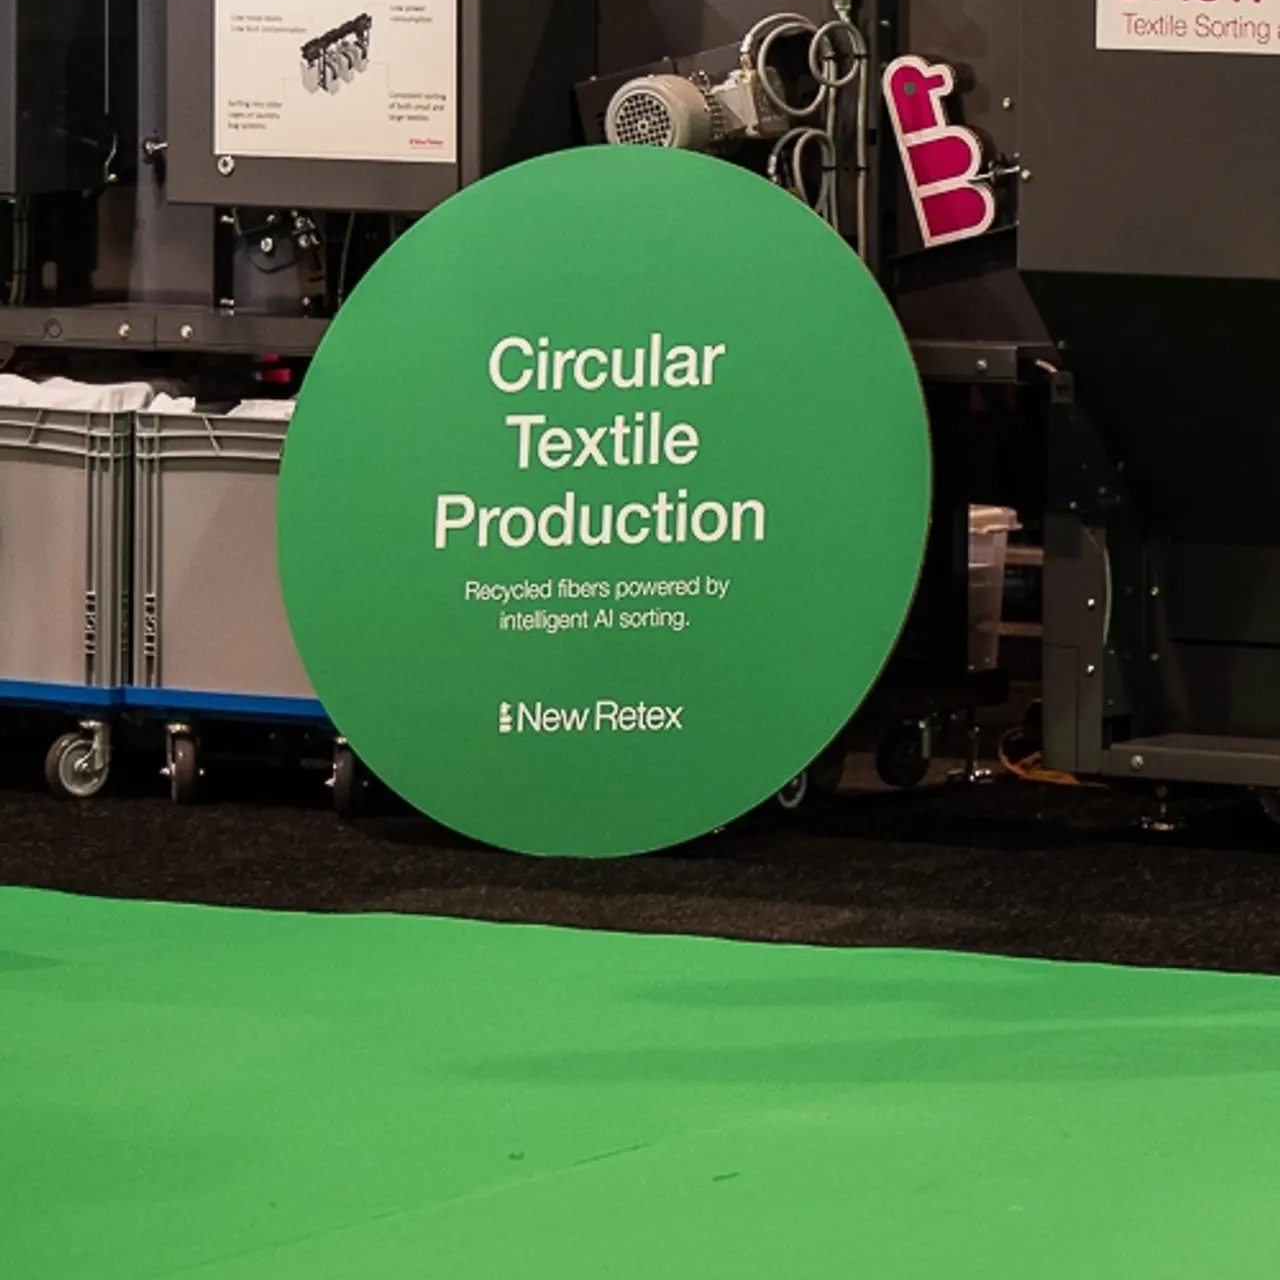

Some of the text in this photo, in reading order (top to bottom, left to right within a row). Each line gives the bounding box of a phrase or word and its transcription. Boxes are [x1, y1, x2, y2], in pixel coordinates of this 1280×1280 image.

[1123, 13, 1188, 38] Textile
[1194, 15, 1271, 45] Sorting
[489, 333, 726, 393] Circular
[505, 411, 700, 469] Textile
[434, 489, 765, 549] Production
[465, 576, 730, 604] Recycled fibers powered by
[500, 608, 690, 634] intelligent AI sorting.
[517, 699, 684, 734] New Retex
